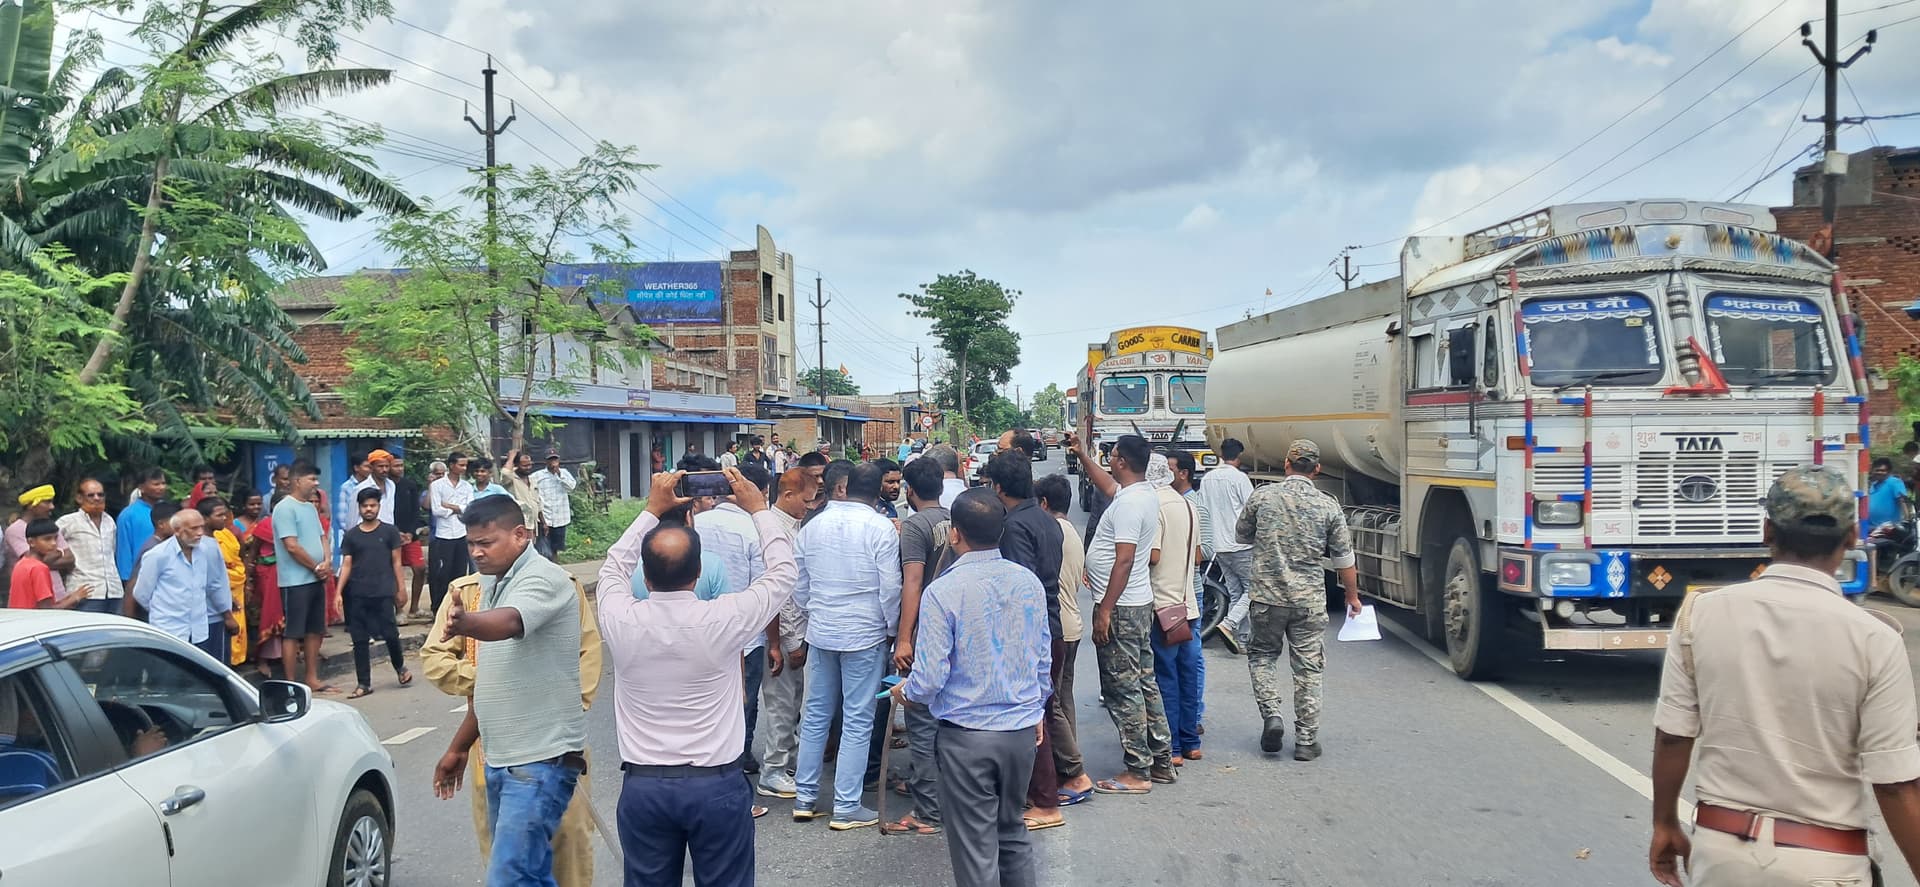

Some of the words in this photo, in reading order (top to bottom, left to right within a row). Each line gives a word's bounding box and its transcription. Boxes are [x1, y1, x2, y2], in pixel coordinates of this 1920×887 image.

[644, 282, 698, 290] WEATHER365
[1539, 302, 1589, 312] जय
[1722, 299, 1802, 312] भद्रकाली
[1117, 333, 1145, 350] GOODS
[1171, 333, 1200, 348] CARRIER
[1186, 355, 1203, 365] VAN
[1637, 431, 1657, 448] शुभ
[1675, 437, 1724, 450] TATA
